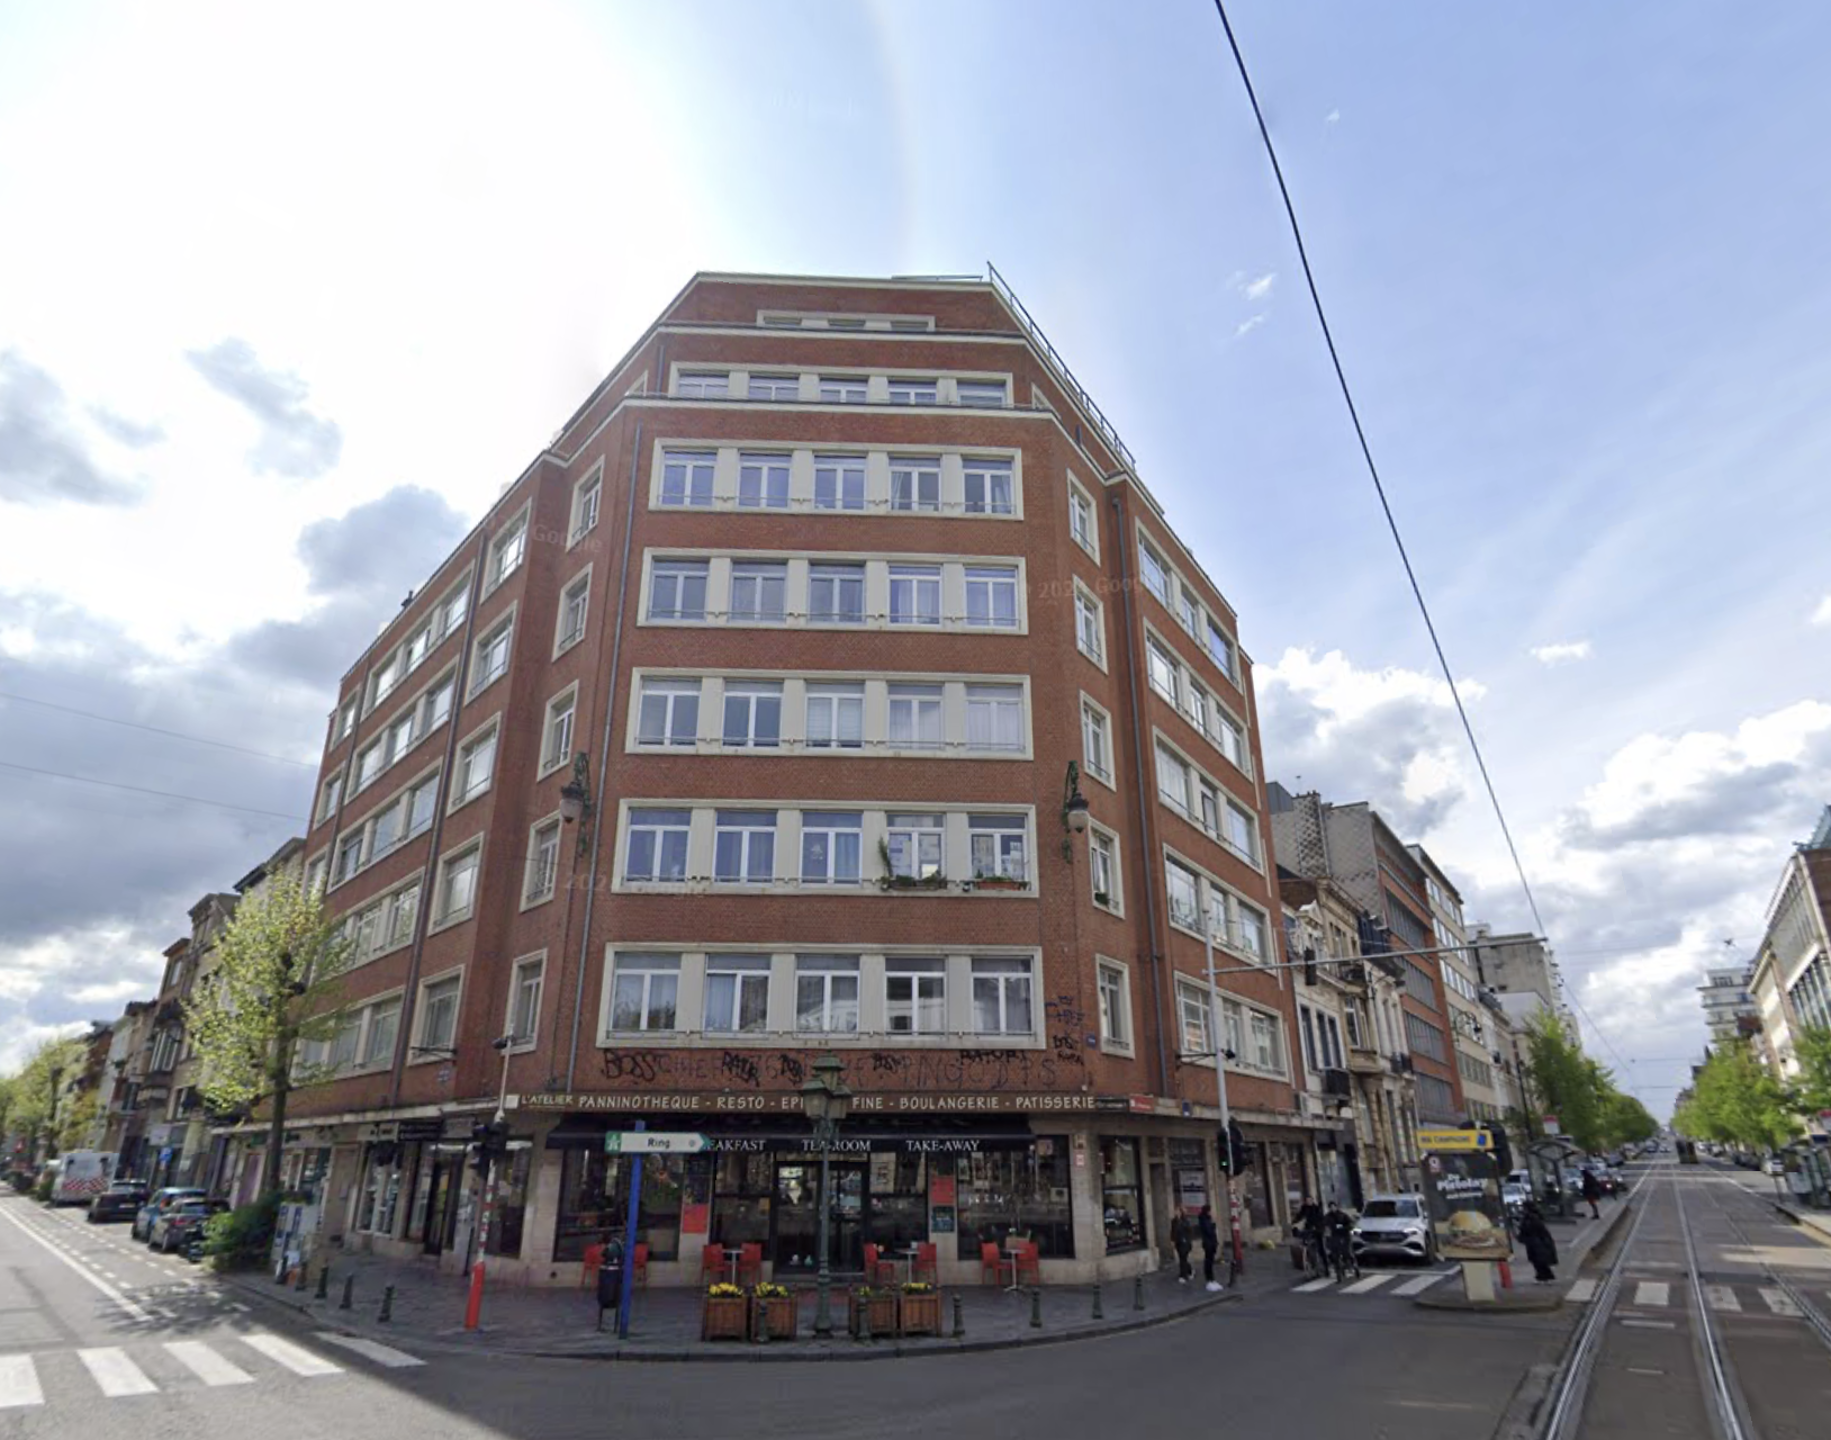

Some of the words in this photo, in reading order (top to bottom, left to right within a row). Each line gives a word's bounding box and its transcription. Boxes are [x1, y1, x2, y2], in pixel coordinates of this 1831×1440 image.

[522, 1094, 573, 1104] L'ATELIER
[578, 1096, 699, 1109] PANNINOTHEQUE
[717, 1096, 765, 1109] RESTO
[851, 1097, 884, 1109] FINE
[899, 1096, 999, 1110] BOULANGERIE
[1016, 1096, 1096, 1109] PATISSERIE
[647, 1138, 670, 1148] Ring
[704, 1140, 766, 1151] EAKFAST
[906, 1140, 980, 1151] TAKE-AWAY
